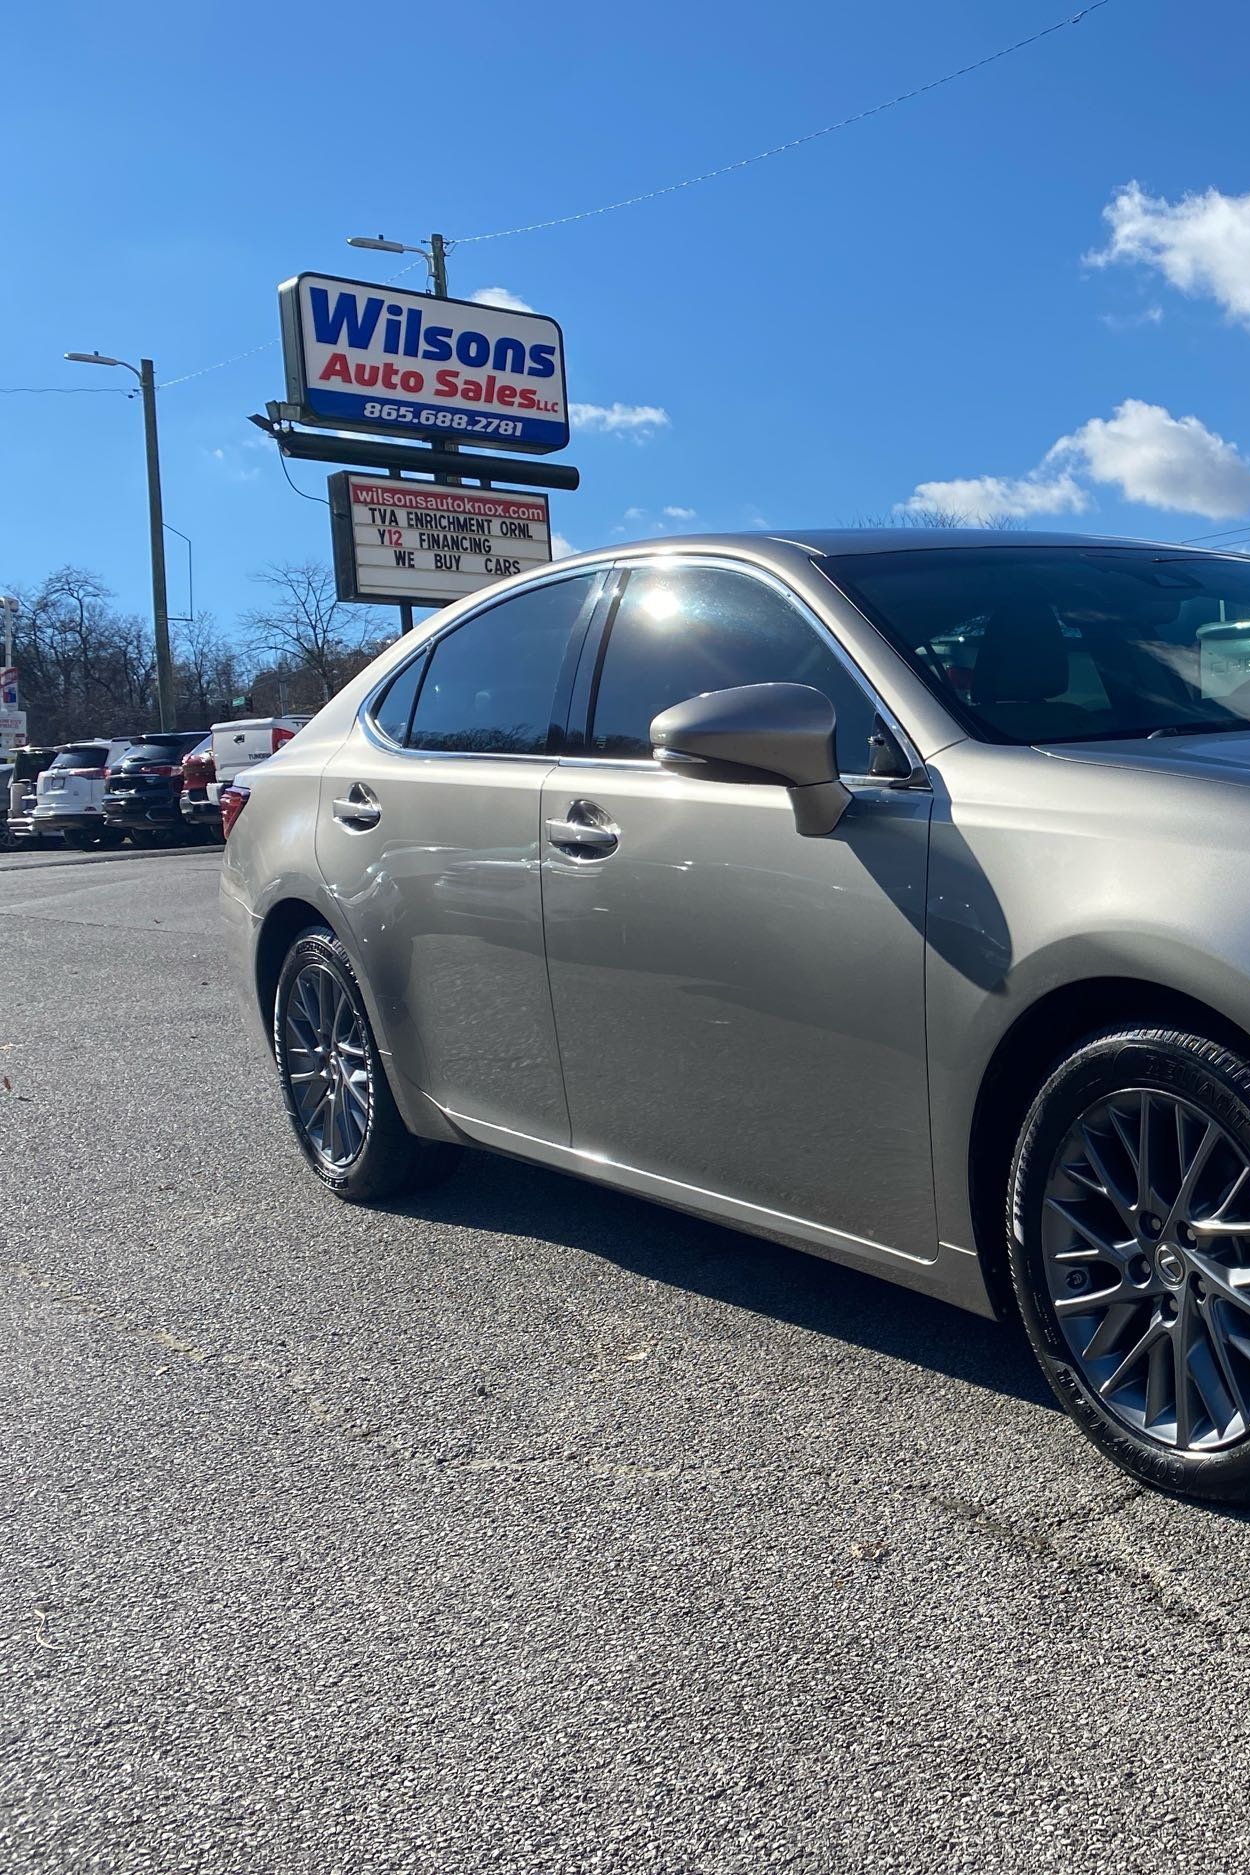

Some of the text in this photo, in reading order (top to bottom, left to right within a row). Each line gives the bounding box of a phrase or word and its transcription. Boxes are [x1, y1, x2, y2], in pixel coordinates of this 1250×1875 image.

[309, 286, 556, 378] Wilsons
[319, 353, 559, 413] Auto Sales LLC
[363, 402, 523, 437] 865.688.2781
[357, 488, 543, 520] wilsonsautoknox.com
[368, 507, 533, 539] TVA ENRICHMENT ORNL
[377, 528, 492, 553] Y12 FINANCING
[394, 550, 521, 575] WE BUY CARS
